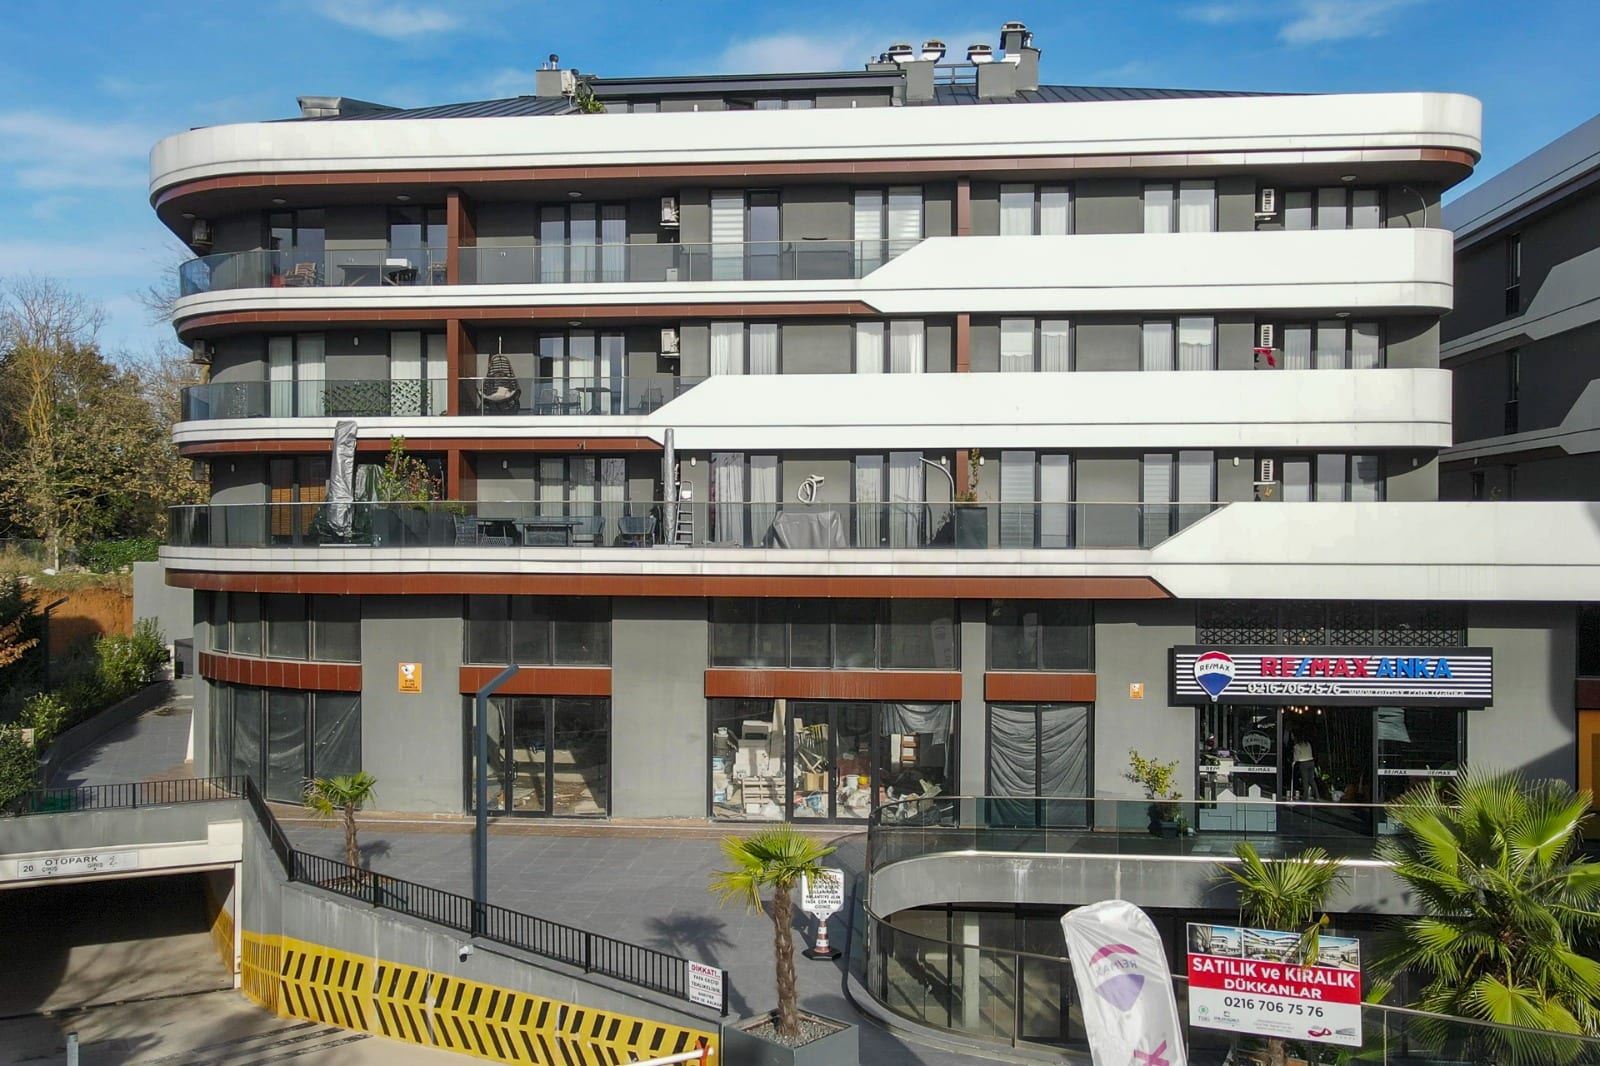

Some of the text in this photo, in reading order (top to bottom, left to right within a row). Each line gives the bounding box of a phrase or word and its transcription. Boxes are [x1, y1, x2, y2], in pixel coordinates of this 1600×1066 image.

[1199, 663, 1230, 672] RE/MAX
[1260, 657, 1453, 678] RE/MAX ANKA
[1247, 683, 1280, 695] 0216
[1281, 683, 1306, 695] 706
[1307, 683, 1326, 695] 75
[1326, 683, 1341, 695] 76
[23, 864, 34, 872] 20
[45, 855, 98, 866] OTOPARK
[1192, 957, 1257, 977] SATILIK
[1261, 966, 1280, 979] ve
[1224, 978, 1322, 999] DÜKKANLAR
[1224, 996, 1324, 1018] 0216 706 75 76
